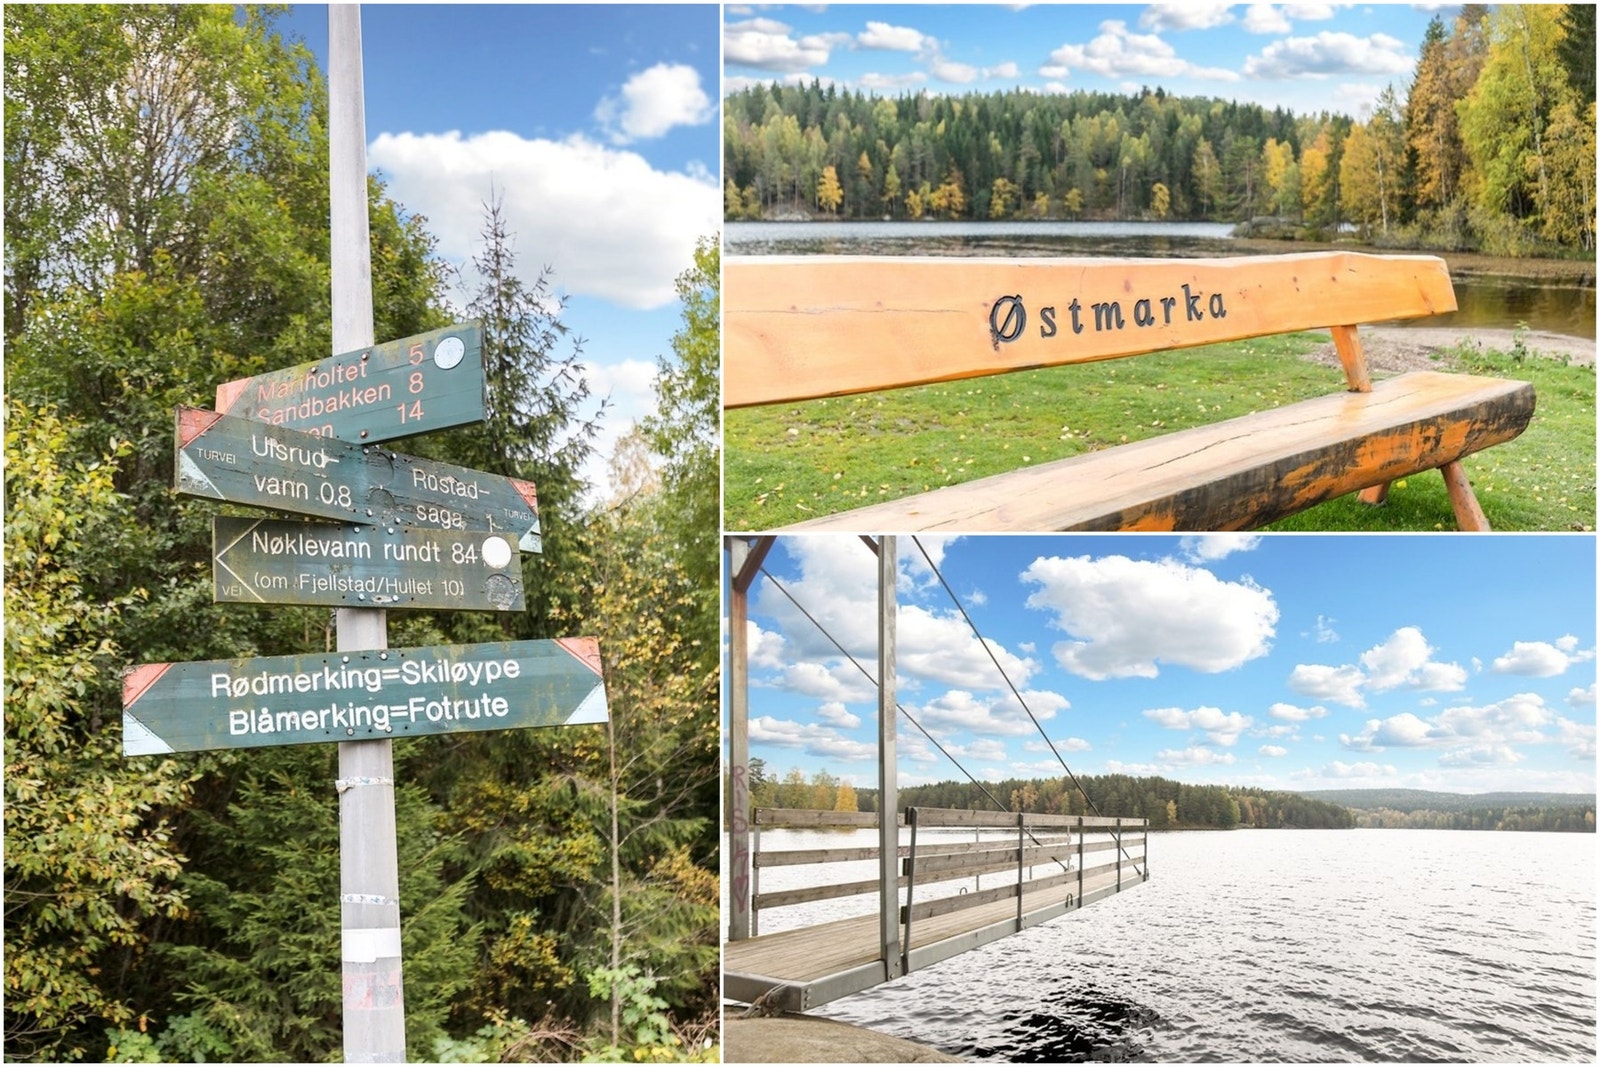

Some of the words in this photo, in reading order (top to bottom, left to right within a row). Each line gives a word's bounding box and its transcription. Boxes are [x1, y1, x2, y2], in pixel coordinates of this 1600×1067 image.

[989, 284, 1227, 343] Østmarka
[257, 360, 368, 402] Mariholtet
[409, 343, 424, 366] 5
[257, 383, 391, 425] Sandbakken
[409, 372, 424, 394] 8
[397, 400, 425, 424] 14
[197, 448, 236, 464] TURVEI
[254, 474, 309, 500] vann
[503, 508, 531, 521] TURVEI
[252, 531, 371, 559] Nøklevann
[384, 541, 441, 563] rundt
[222, 585, 242, 597] VEI
[254, 572, 288, 589] (om
[299, 574, 433, 595] Fjellstad/Hullet
[441, 579, 464, 596] 10)
[211, 658, 521, 698] Rødmerking=Skiløype
[229, 692, 509, 736] Blåmerking=Fotrute
